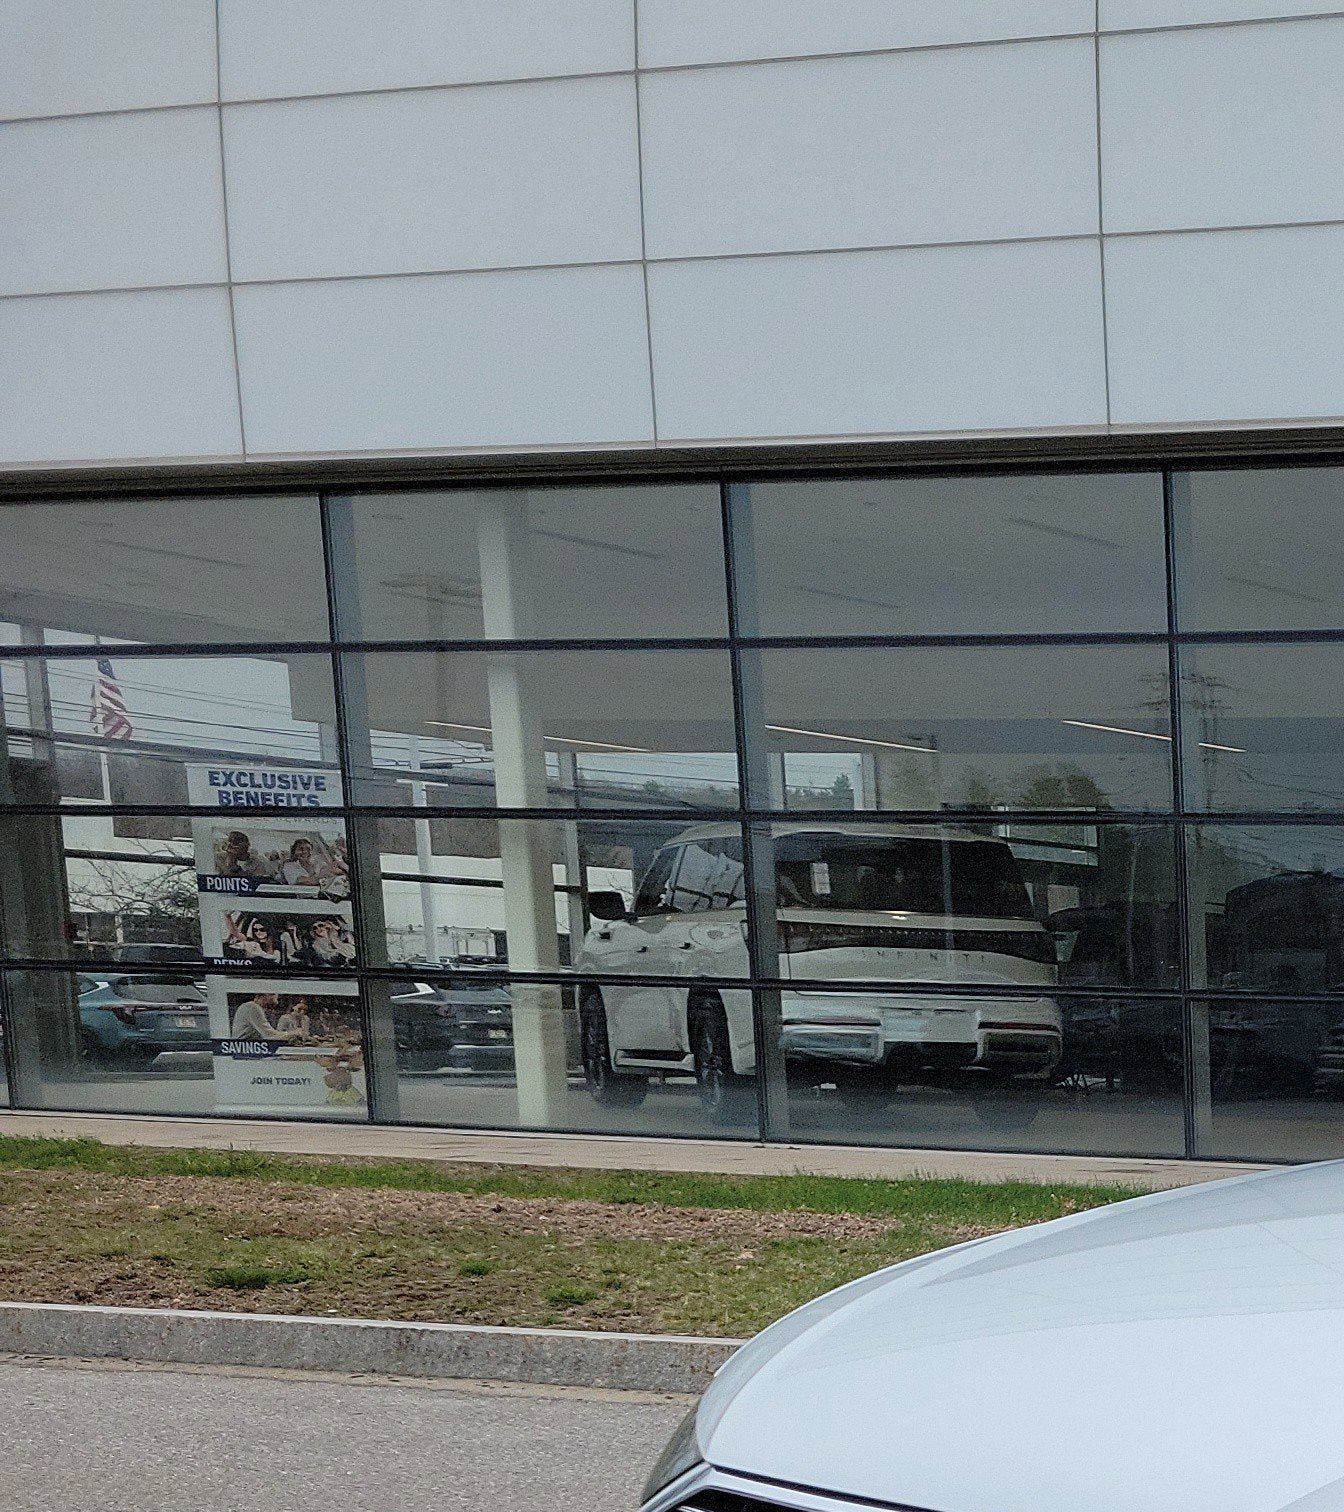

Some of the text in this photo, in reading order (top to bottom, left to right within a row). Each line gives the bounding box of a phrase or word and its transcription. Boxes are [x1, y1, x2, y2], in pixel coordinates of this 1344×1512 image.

[208, 771, 327, 791] EXCLUSIVE
[217, 790, 321, 807] BENEFITS
[206, 876, 252, 891] POINTS.
[221, 1041, 271, 1054] SAVINGS.
[250, 1077, 273, 1085] JOIN
